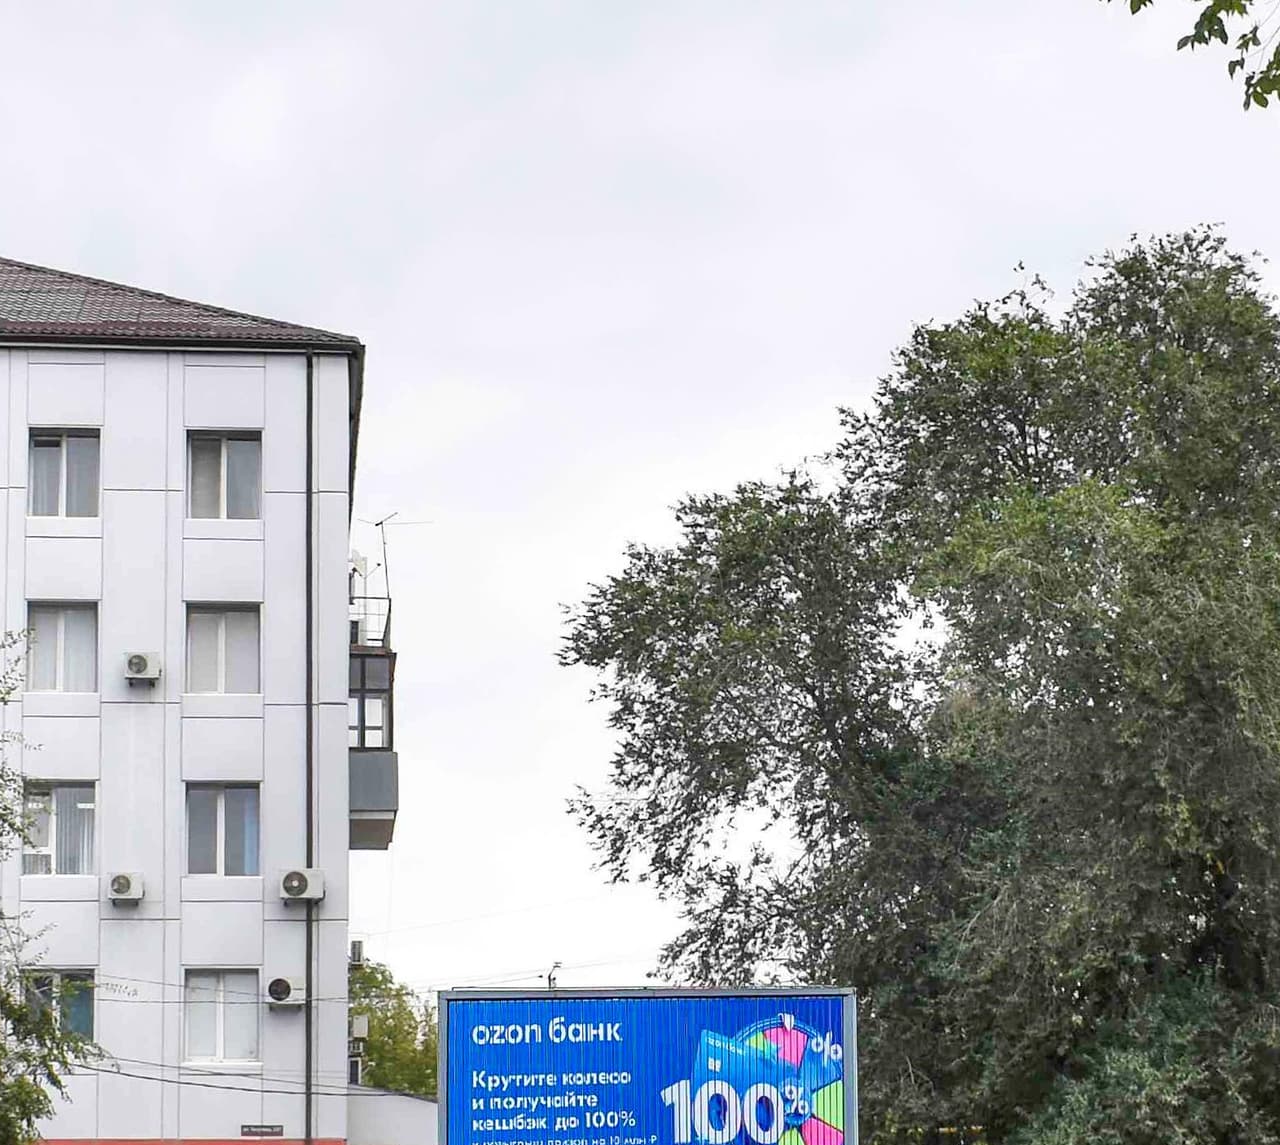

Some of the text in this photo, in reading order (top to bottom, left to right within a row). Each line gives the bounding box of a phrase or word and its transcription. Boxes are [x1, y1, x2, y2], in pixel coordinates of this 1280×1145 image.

[472, 1016, 623, 1045] ozon банк
[472, 1070, 631, 1091] Крутите колесо
[472, 1091, 598, 1112] и получайте
[660, 1079, 809, 1145] 100%
[472, 1110, 636, 1131] кешбэк до 100%
